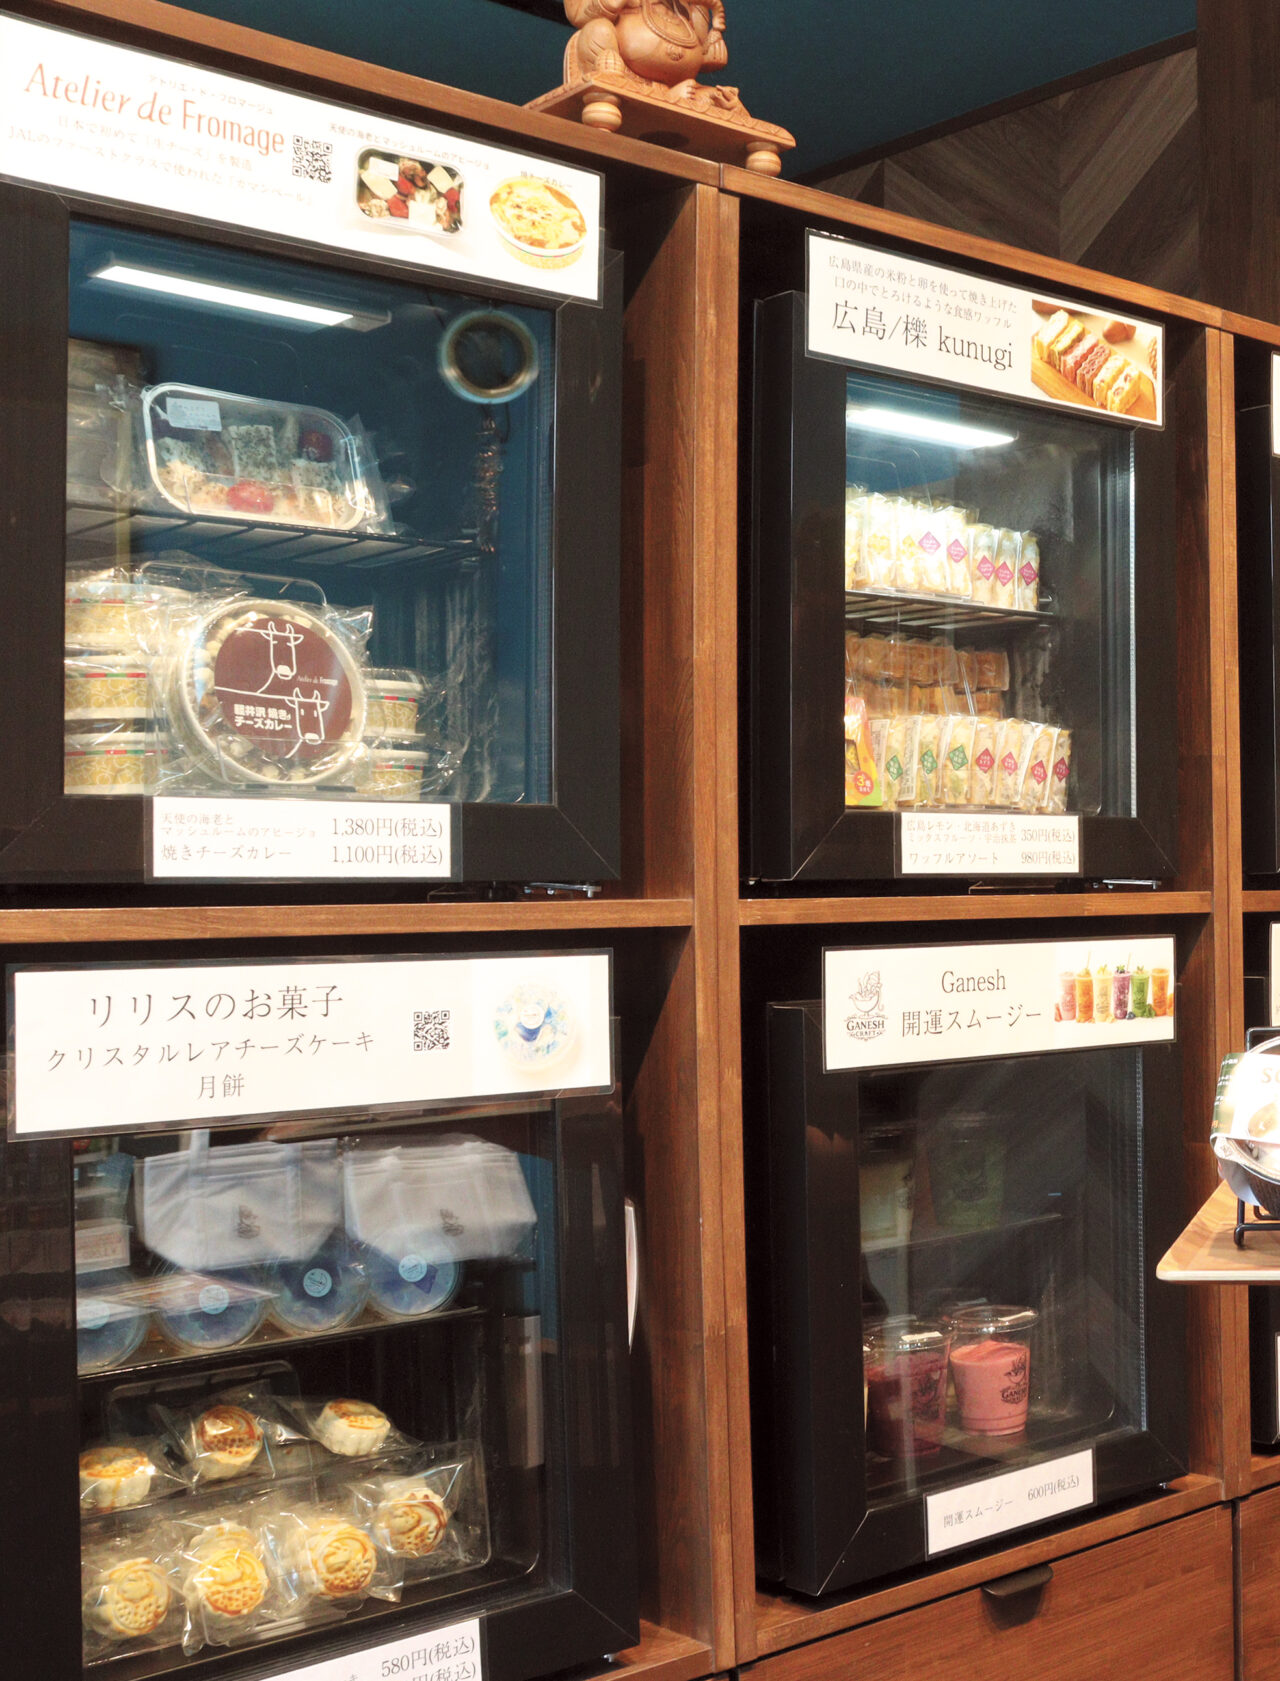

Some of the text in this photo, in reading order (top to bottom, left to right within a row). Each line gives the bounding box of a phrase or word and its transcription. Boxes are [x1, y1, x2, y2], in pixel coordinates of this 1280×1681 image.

[24, 62, 286, 157] Atelier de Fromage
[828, 255, 1018, 315] 広島県産の米粉と卵を使って焼き上げた
[938, 325, 1014, 371] kunugi
[234, 716, 293, 732] チーズカレー
[161, 844, 293, 861] 焼きチーズカレー
[908, 850, 999, 866] ワッフルアソート
[941, 968, 1007, 995] Ganesh
[89, 984, 344, 1029] リリスのお菓子
[846, 1019, 885, 1031] GANESH
[901, 1003, 1042, 1038] 開運スムージー
[47, 1031, 375, 1072] クリスタルレアチーズケーキ
[198, 1073, 246, 1100] 月餅
[943, 1474, 1080, 1529] 開運スムージー 600円(税込)
[381, 1636, 475, 1679] 580円(税込)
